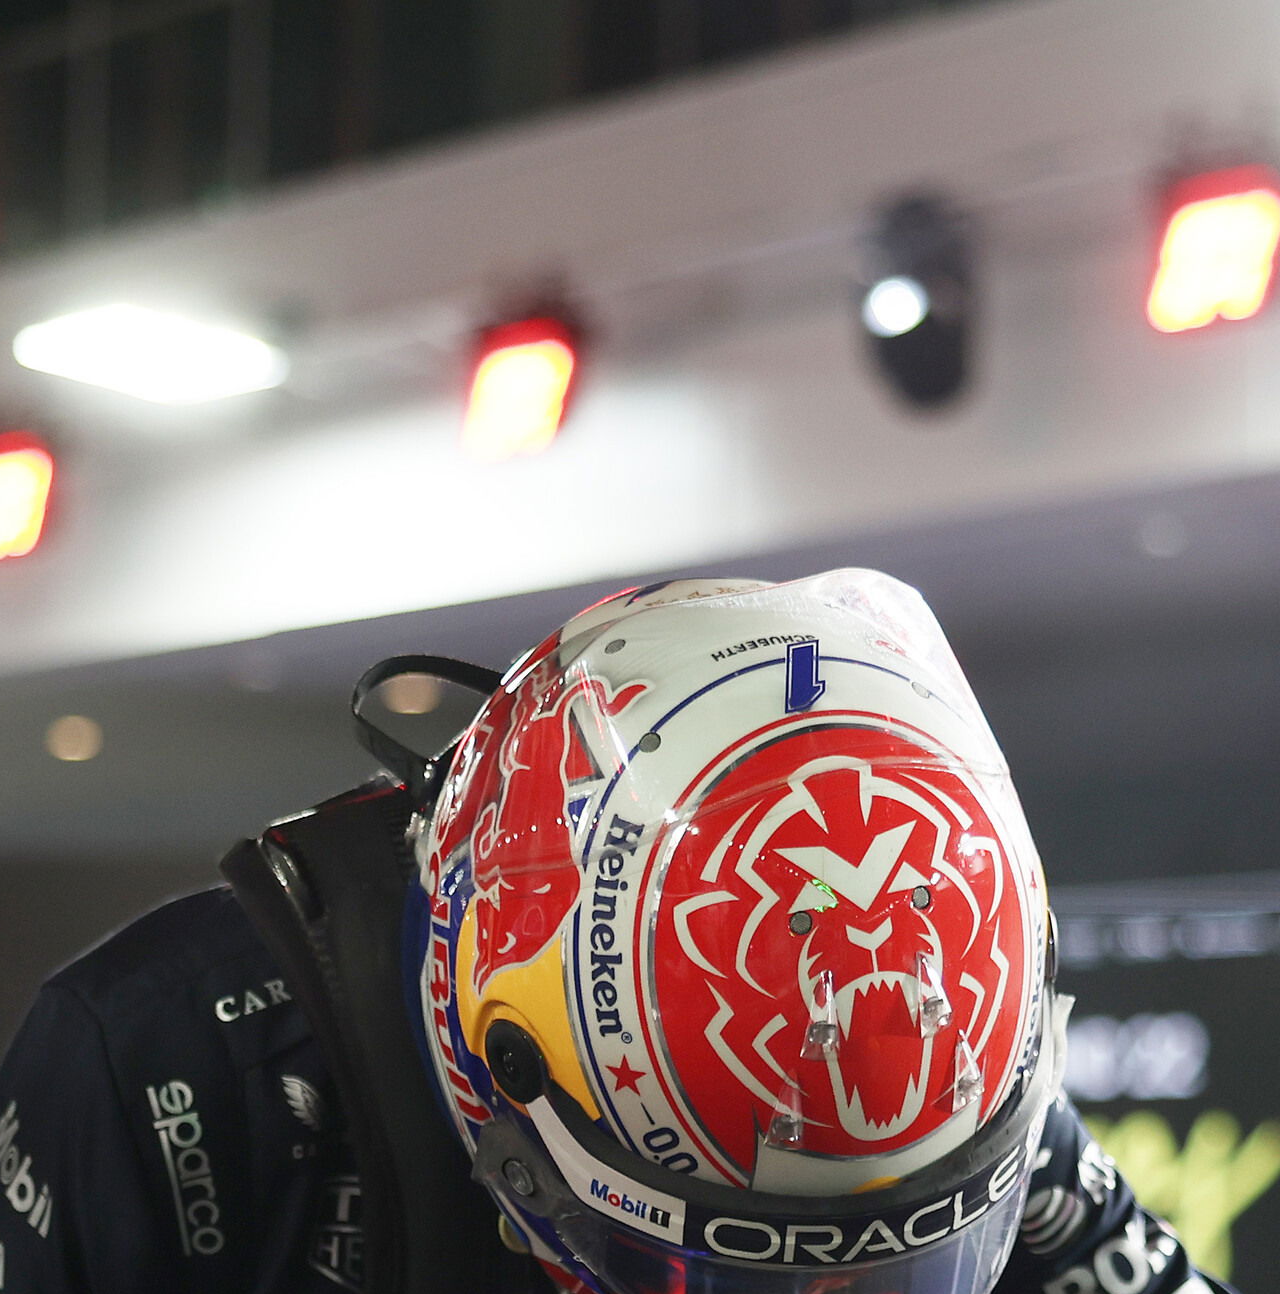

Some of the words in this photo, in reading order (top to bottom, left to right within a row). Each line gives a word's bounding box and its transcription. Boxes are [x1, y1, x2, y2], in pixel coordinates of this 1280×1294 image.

[153, 1080, 224, 1255] sparco
[589, 1178, 647, 1220] Mobil
[704, 1145, 1021, 1264] ORACLE
